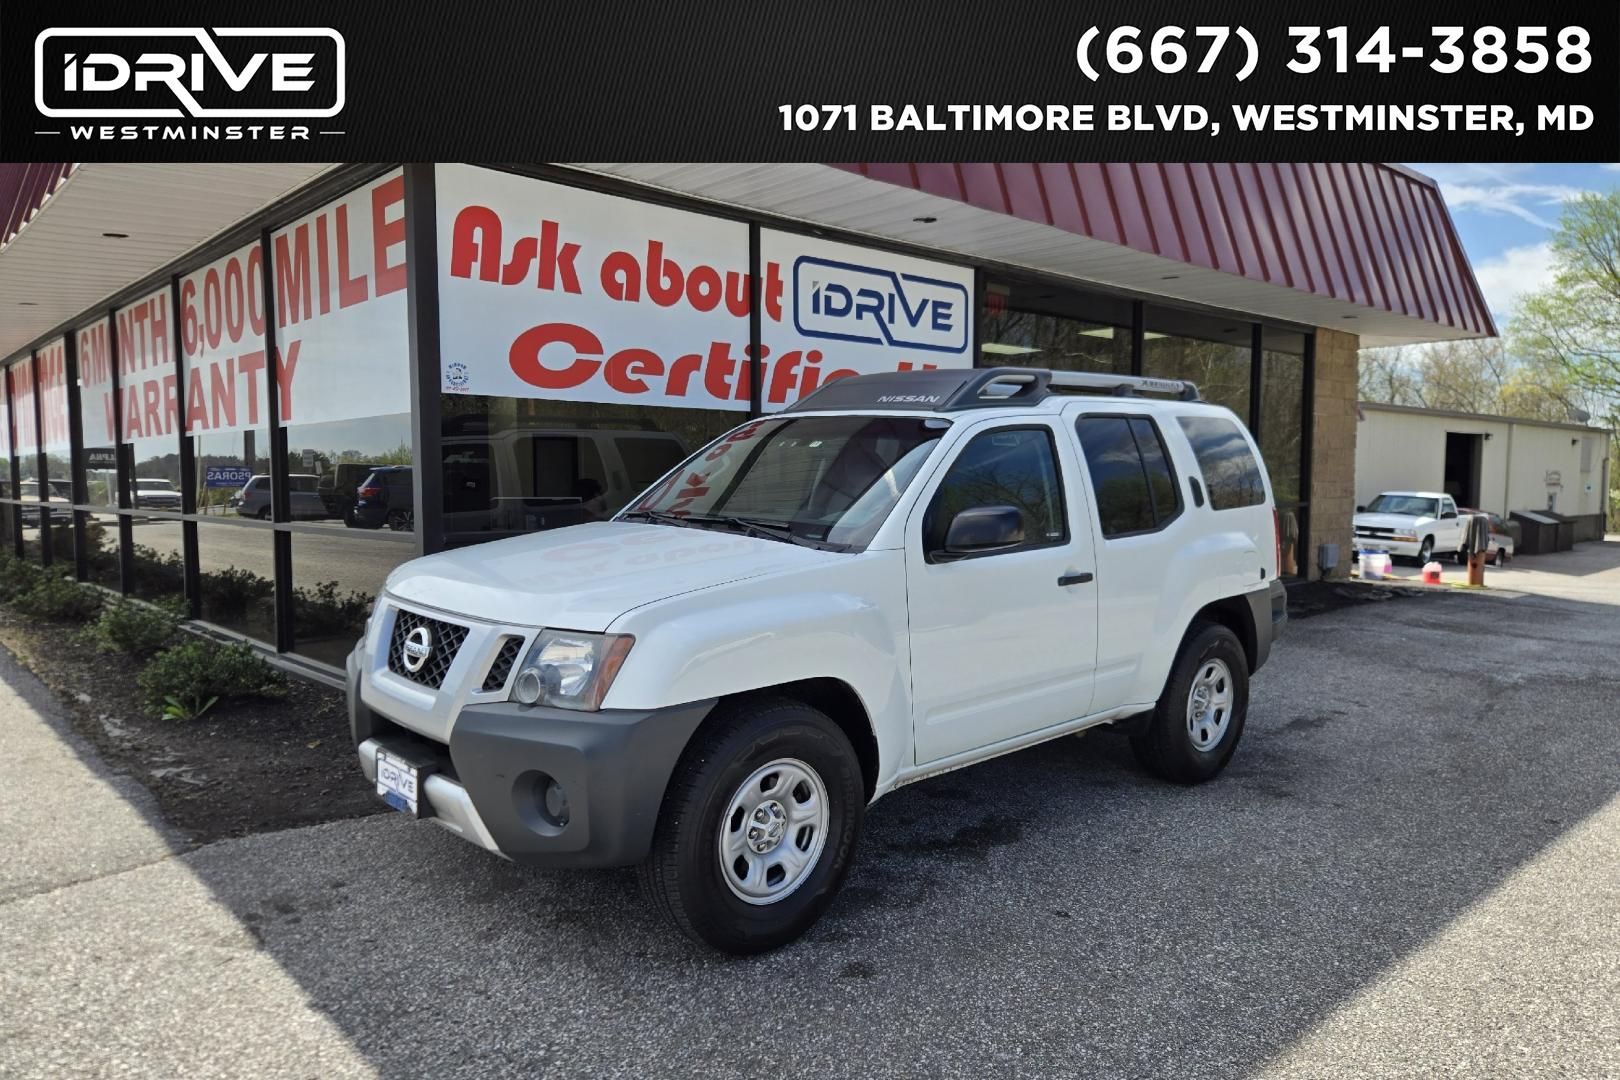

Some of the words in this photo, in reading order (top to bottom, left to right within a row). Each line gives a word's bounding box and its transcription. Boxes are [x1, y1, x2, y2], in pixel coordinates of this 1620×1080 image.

[275, 174, 408, 328] MILE
[451, 205, 582, 295] Ask
[600, 240, 784, 322] about
[104, 339, 302, 442] WARRANTY
[877, 394, 941, 404] NISSAN
